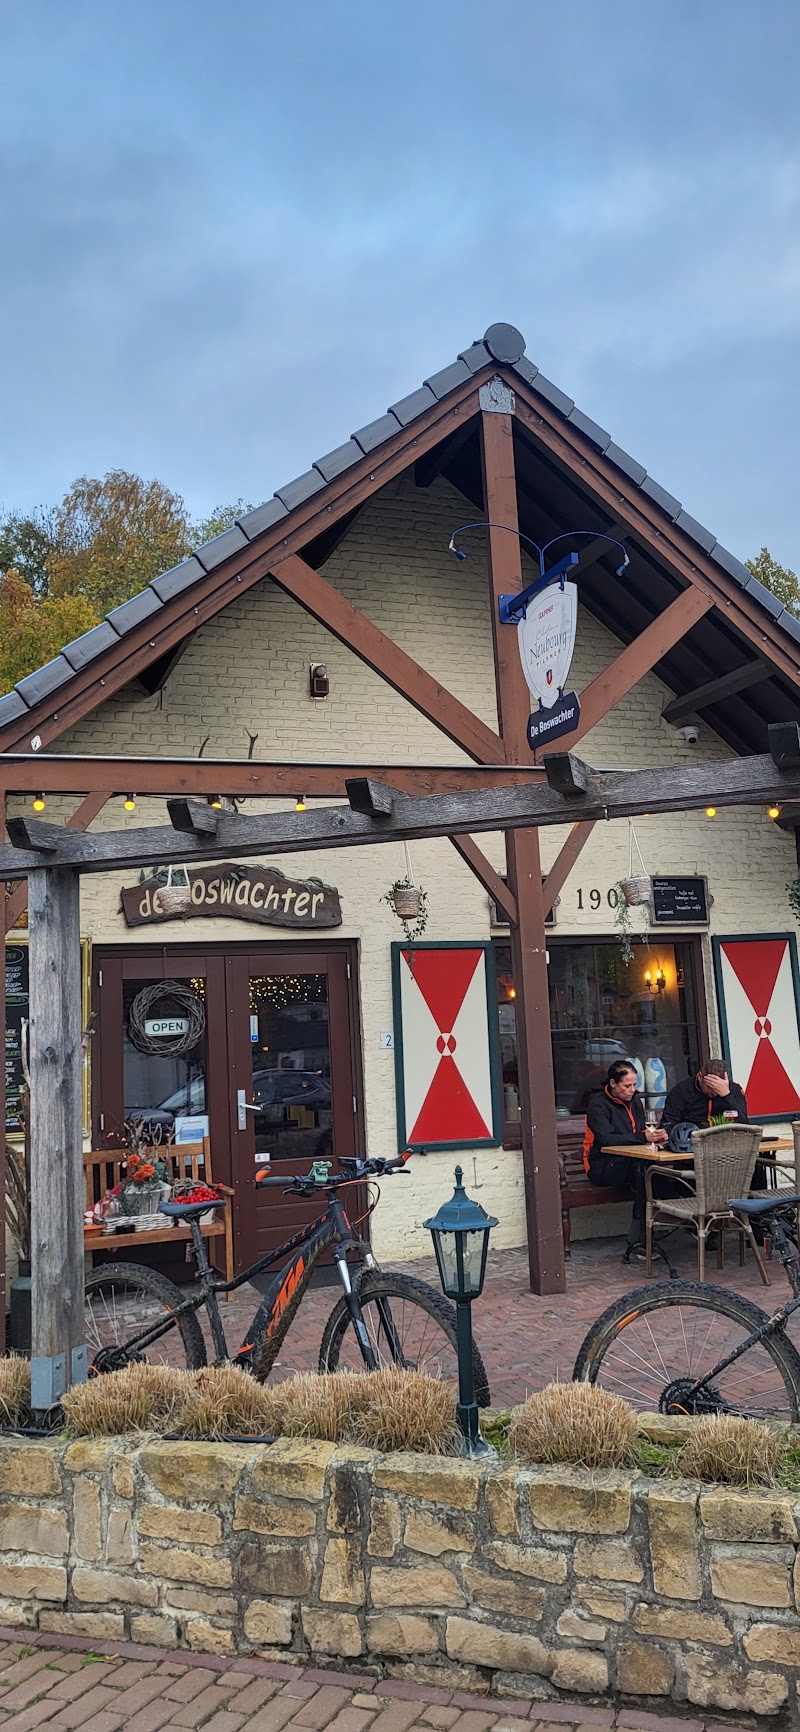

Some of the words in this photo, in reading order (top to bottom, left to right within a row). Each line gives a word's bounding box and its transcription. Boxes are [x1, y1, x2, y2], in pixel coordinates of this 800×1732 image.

[530, 631, 567, 666] Neubourg
[536, 648, 561, 667] PILSNER
[530, 725, 539, 738] De
[539, 707, 575, 734] Boswachter
[190, 878, 325, 919] oswachter
[576, 888, 630, 910] 190
[152, 1021, 184, 1033] OPEN
[386, 1034, 392, 1046] 2
